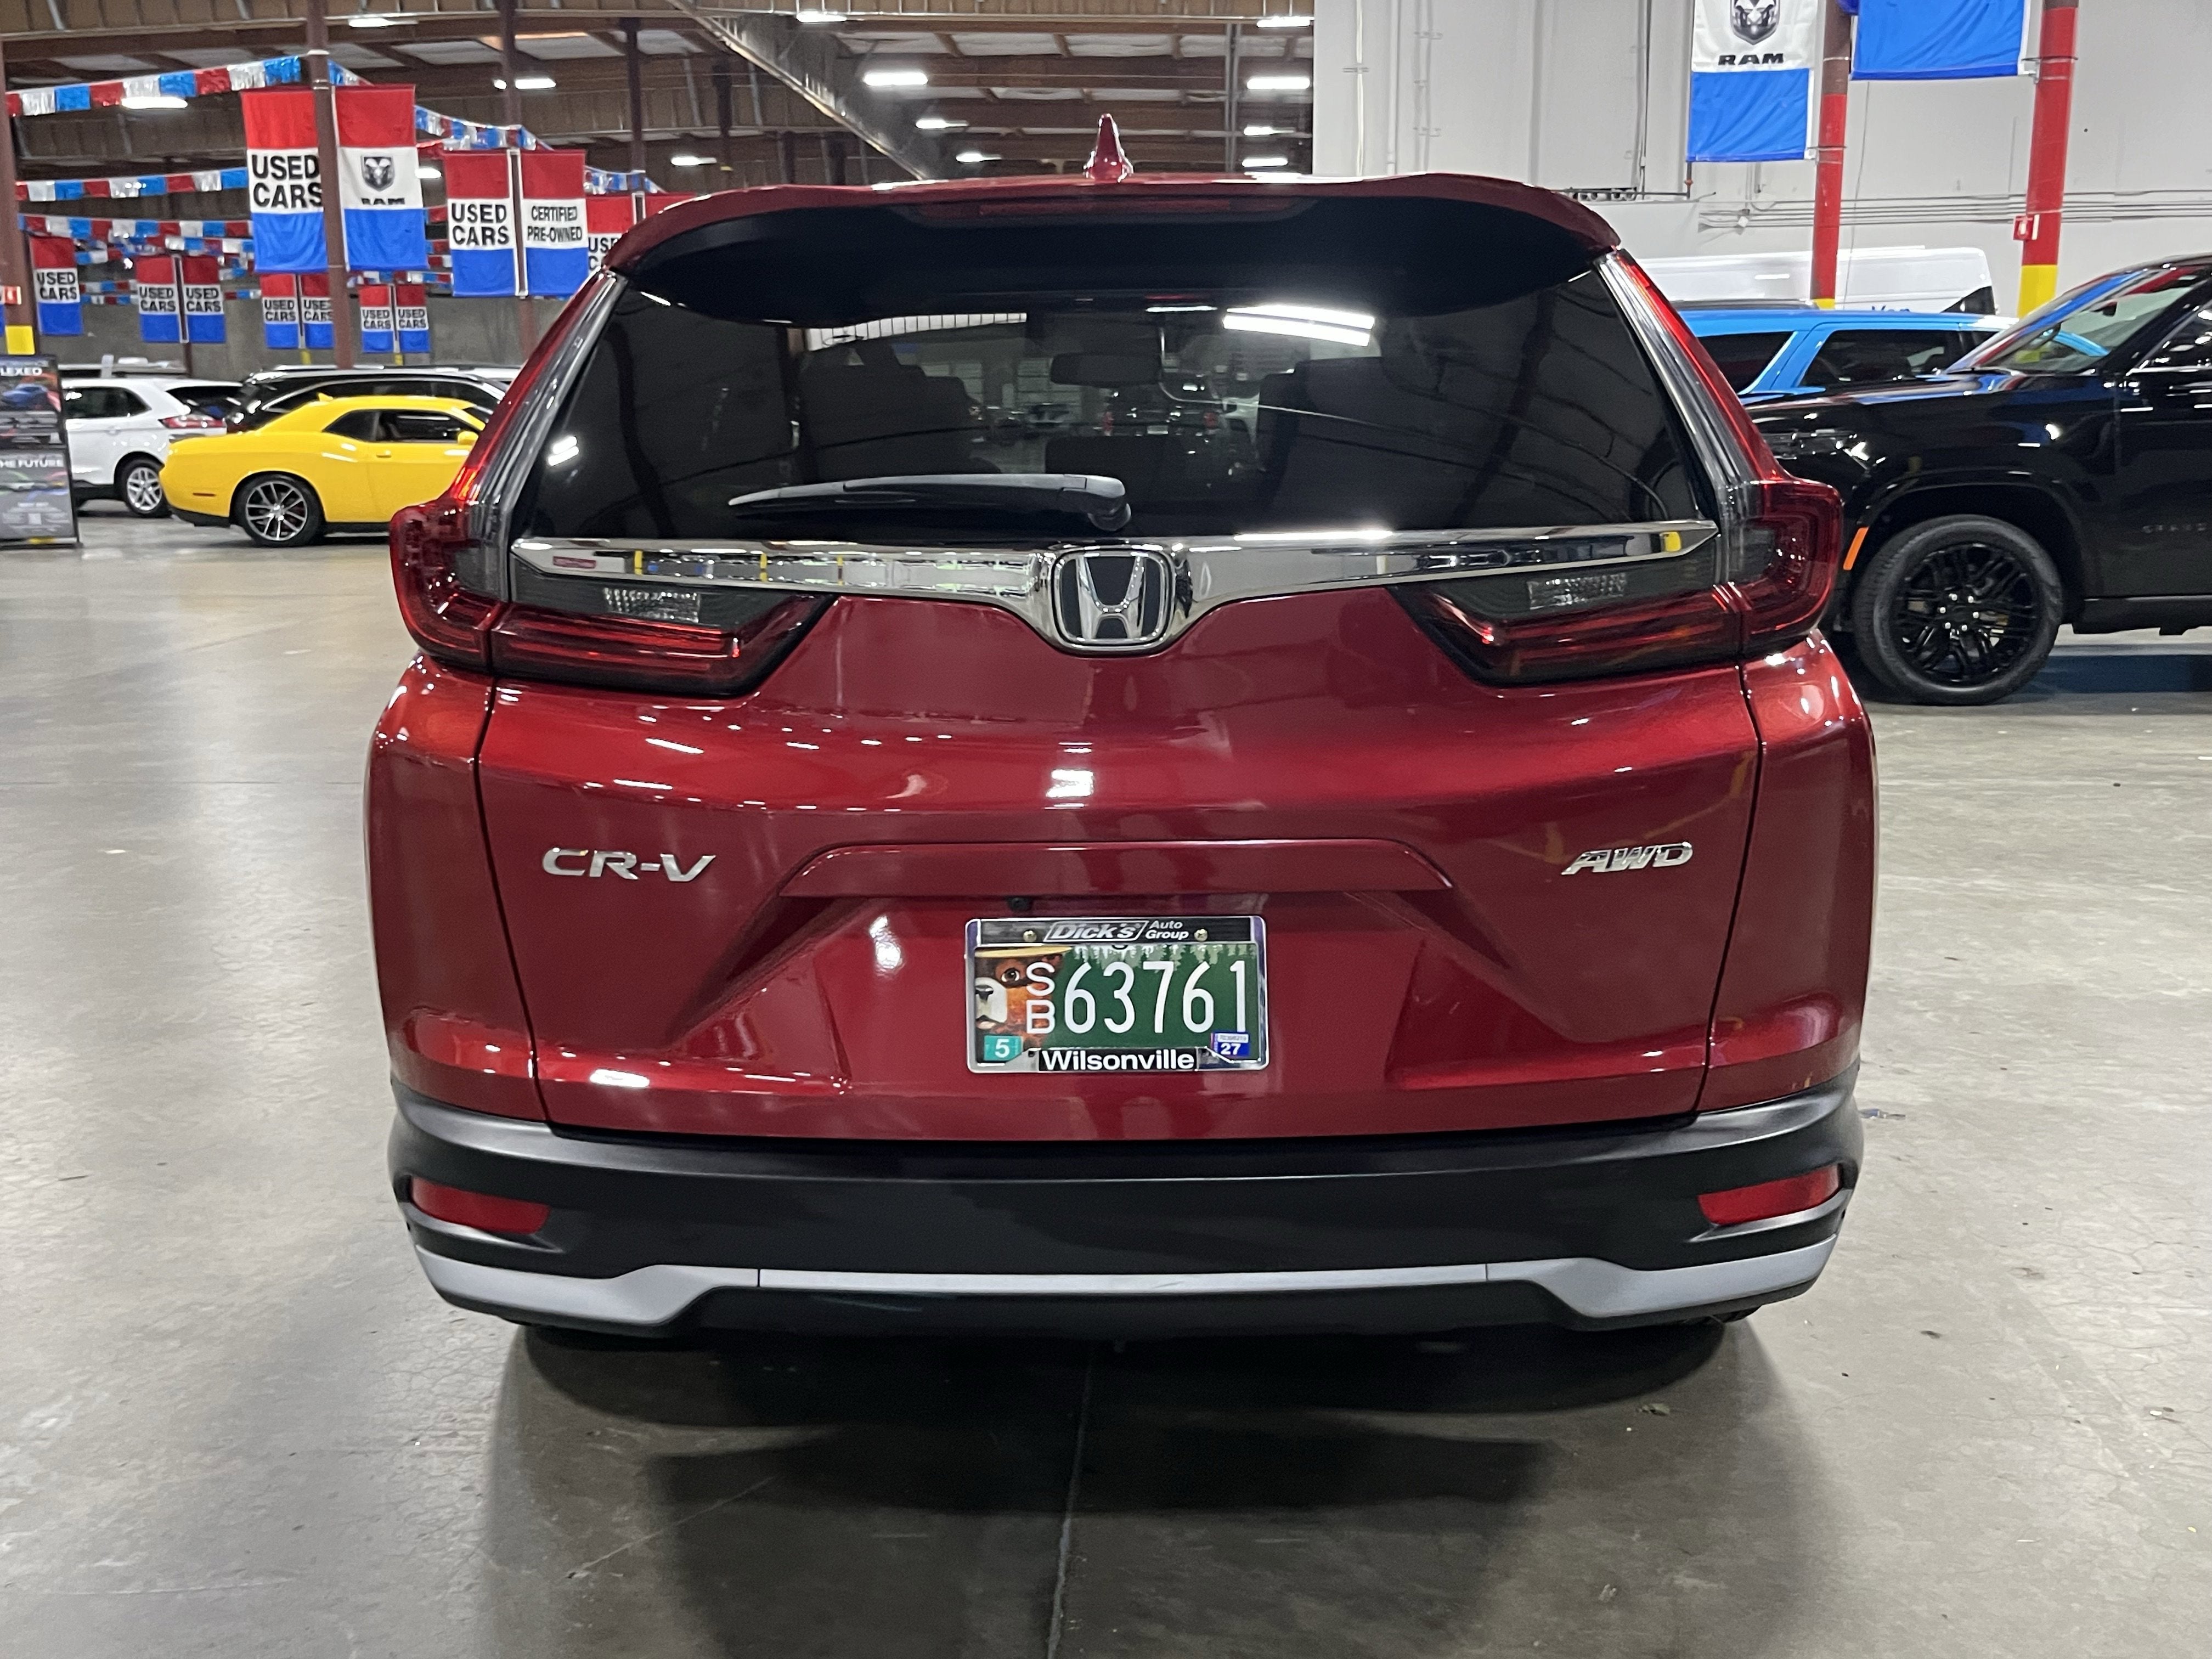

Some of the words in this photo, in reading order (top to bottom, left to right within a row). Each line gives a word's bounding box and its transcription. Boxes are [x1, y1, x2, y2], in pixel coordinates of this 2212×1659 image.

[1718, 53, 1784, 66] RAM
[252, 154, 320, 180] USED
[253, 182, 323, 208] CARS
[451, 202, 507, 223] USED
[531, 206, 578, 221] CERTIFIED
[452, 225, 510, 246] CARS
[527, 226, 583, 242] PRE-OWNED
[588, 237, 618, 253] US
[37, 272, 75, 285] USED
[40, 287, 77, 300] CARS
[139, 286, 173, 298] USED
[186, 287, 218, 299] USED
[140, 300, 176, 311] CARS
[187, 301, 221, 312] CARS
[264, 300, 295, 310] USED
[304, 300, 330, 311] USE
[266, 311, 296, 321] CARS
[363, 309, 390, 318] USED
[398, 309, 425, 318] USED
[363, 319, 391, 329] CARS
[399, 319, 426, 328] CARS
[18, 459, 64, 468] FUTURE
[542, 847, 717, 882] CR-V
[1561, 841, 1694, 875] AWD
[1051, 923, 1136, 939] Dick's
[1149, 920, 1183, 929] Auto
[1145, 929, 1189, 940] Group
[1064, 960, 1246, 1034] 63761
[995, 1039, 1010, 1058] 5
[1220, 1042, 1242, 1056] 27
[1042, 1048, 1195, 1071] Wilsonville
